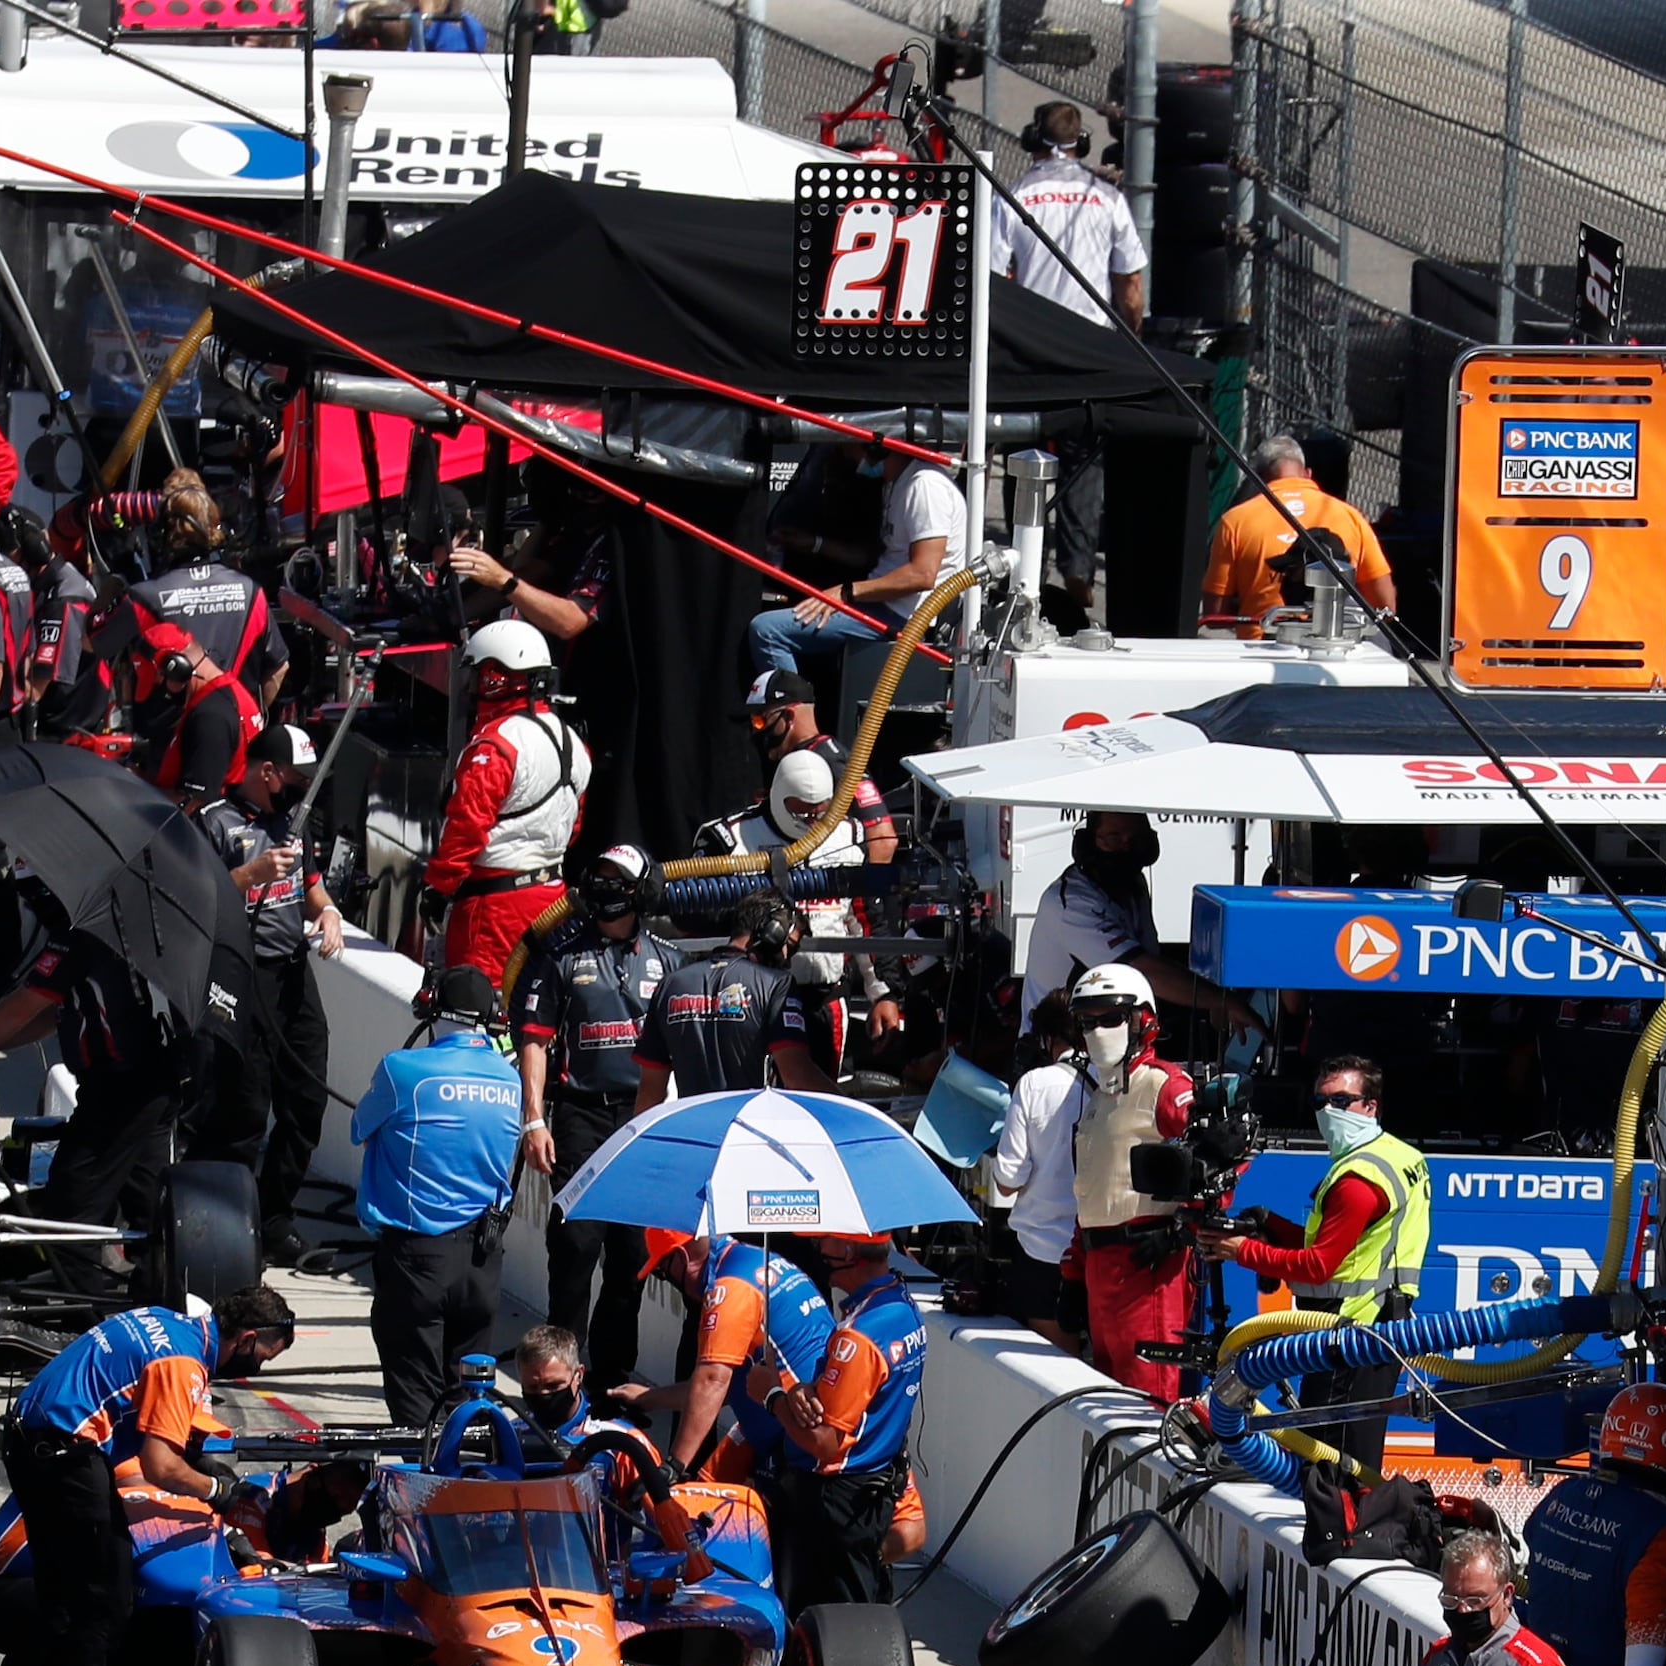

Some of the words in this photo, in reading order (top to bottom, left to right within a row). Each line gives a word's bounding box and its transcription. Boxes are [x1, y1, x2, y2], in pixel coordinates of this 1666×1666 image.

[350, 129, 602, 158] United
[350, 159, 642, 188] Renls
[1024, 193, 1103, 206] HONDA
[819, 198, 946, 325] 21
[1586, 253, 1611, 319] 21
[1530, 431, 1576, 450] PNC
[1577, 432, 1632, 450] BANK
[1505, 460, 1527, 480] CHIP
[1528, 459, 1632, 480] GANASSI
[1504, 480, 1632, 494] RACING
[1539, 534, 1592, 630] 9
[198, 604, 224, 615] TEAM
[1420, 792, 1492, 801] MADE
[1411, 924, 1557, 981] PNC
[438, 1082, 519, 1107] OFFICIAL
[1447, 1172, 1513, 1199] NTT
[762, 1194, 784, 1205] PNC
[785, 1194, 817, 1205] BANK
[763, 1206, 817, 1217] GANASSI
[1437, 1244, 1656, 1361] PN
[1619, 1434, 1654, 1450] HONDA
[1556, 1502, 1585, 1527] PNC
[528, 1619, 606, 1639] PNC
[530, 1633, 581, 1666] 9
